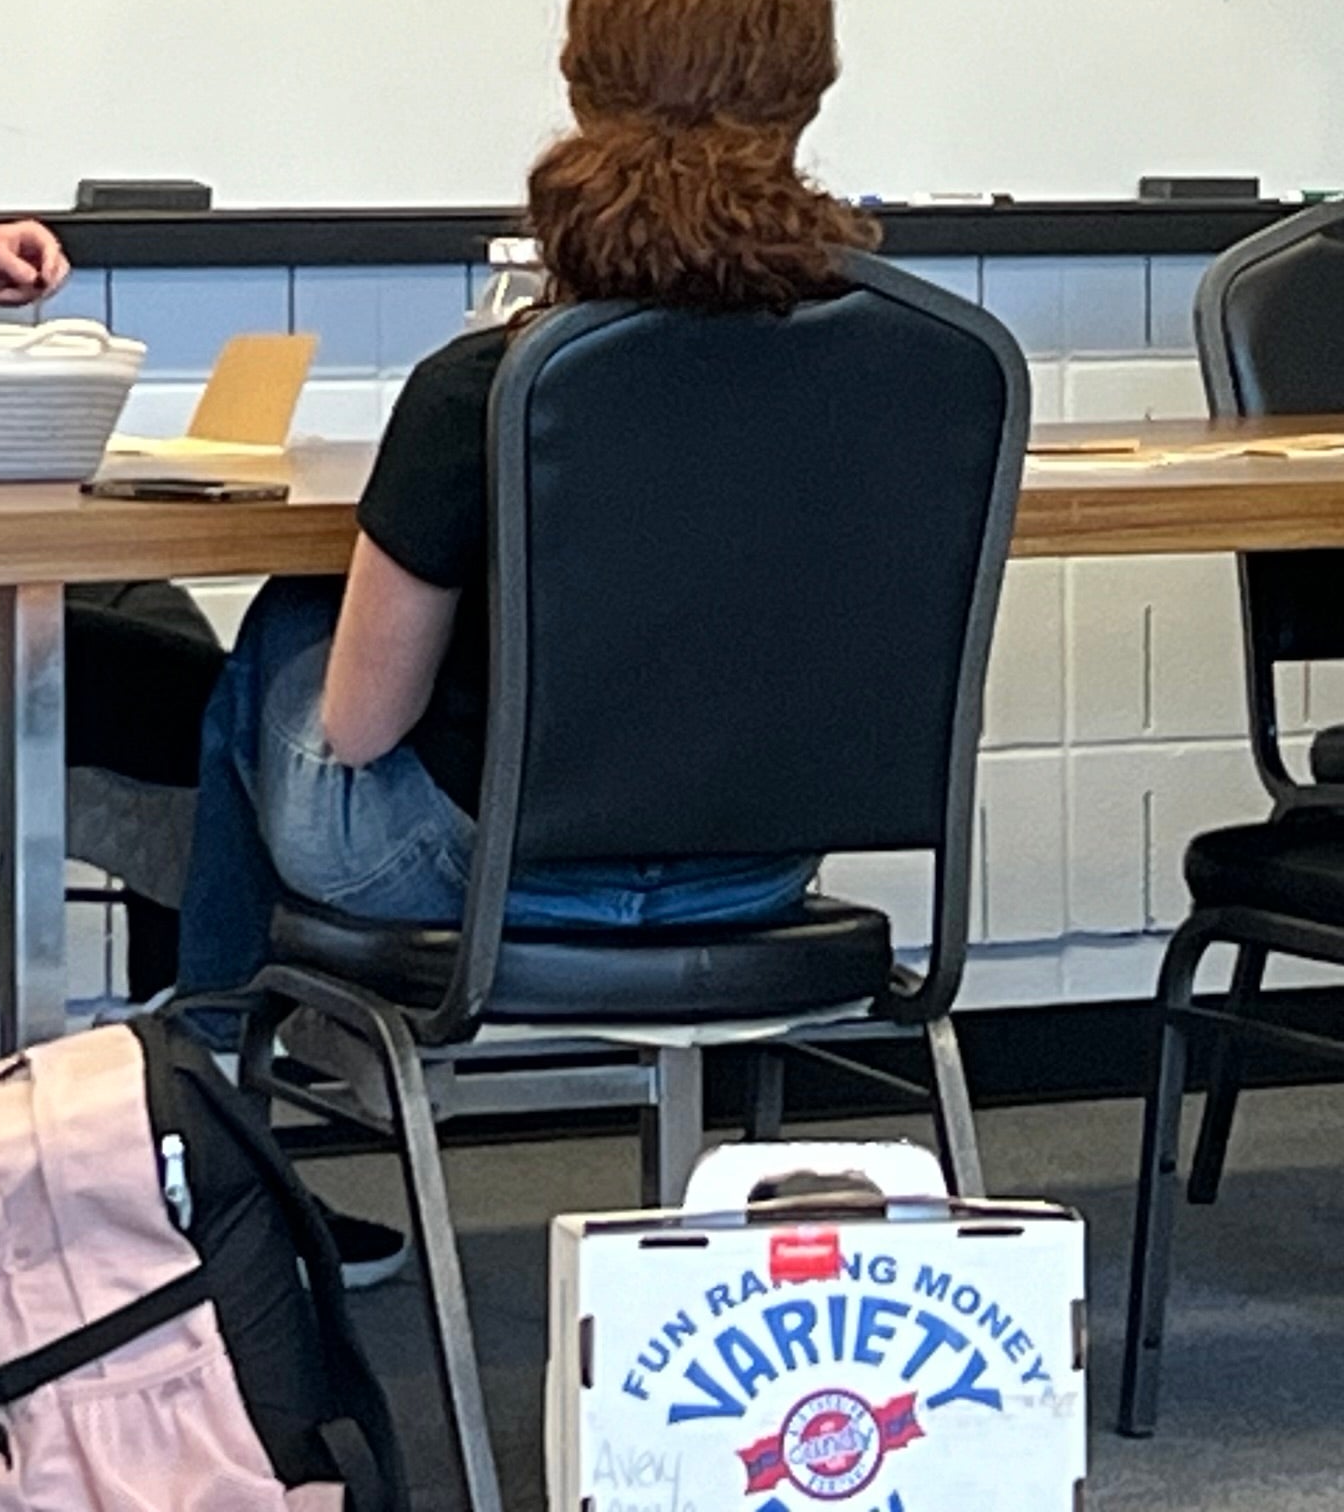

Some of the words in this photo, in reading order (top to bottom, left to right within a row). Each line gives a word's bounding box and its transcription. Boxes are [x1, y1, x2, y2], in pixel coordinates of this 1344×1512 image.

[621, 1309, 699, 1402] FUN
[913, 1264, 1052, 1384] MONEY
[666, 1294, 1004, 1427] VARIETY
